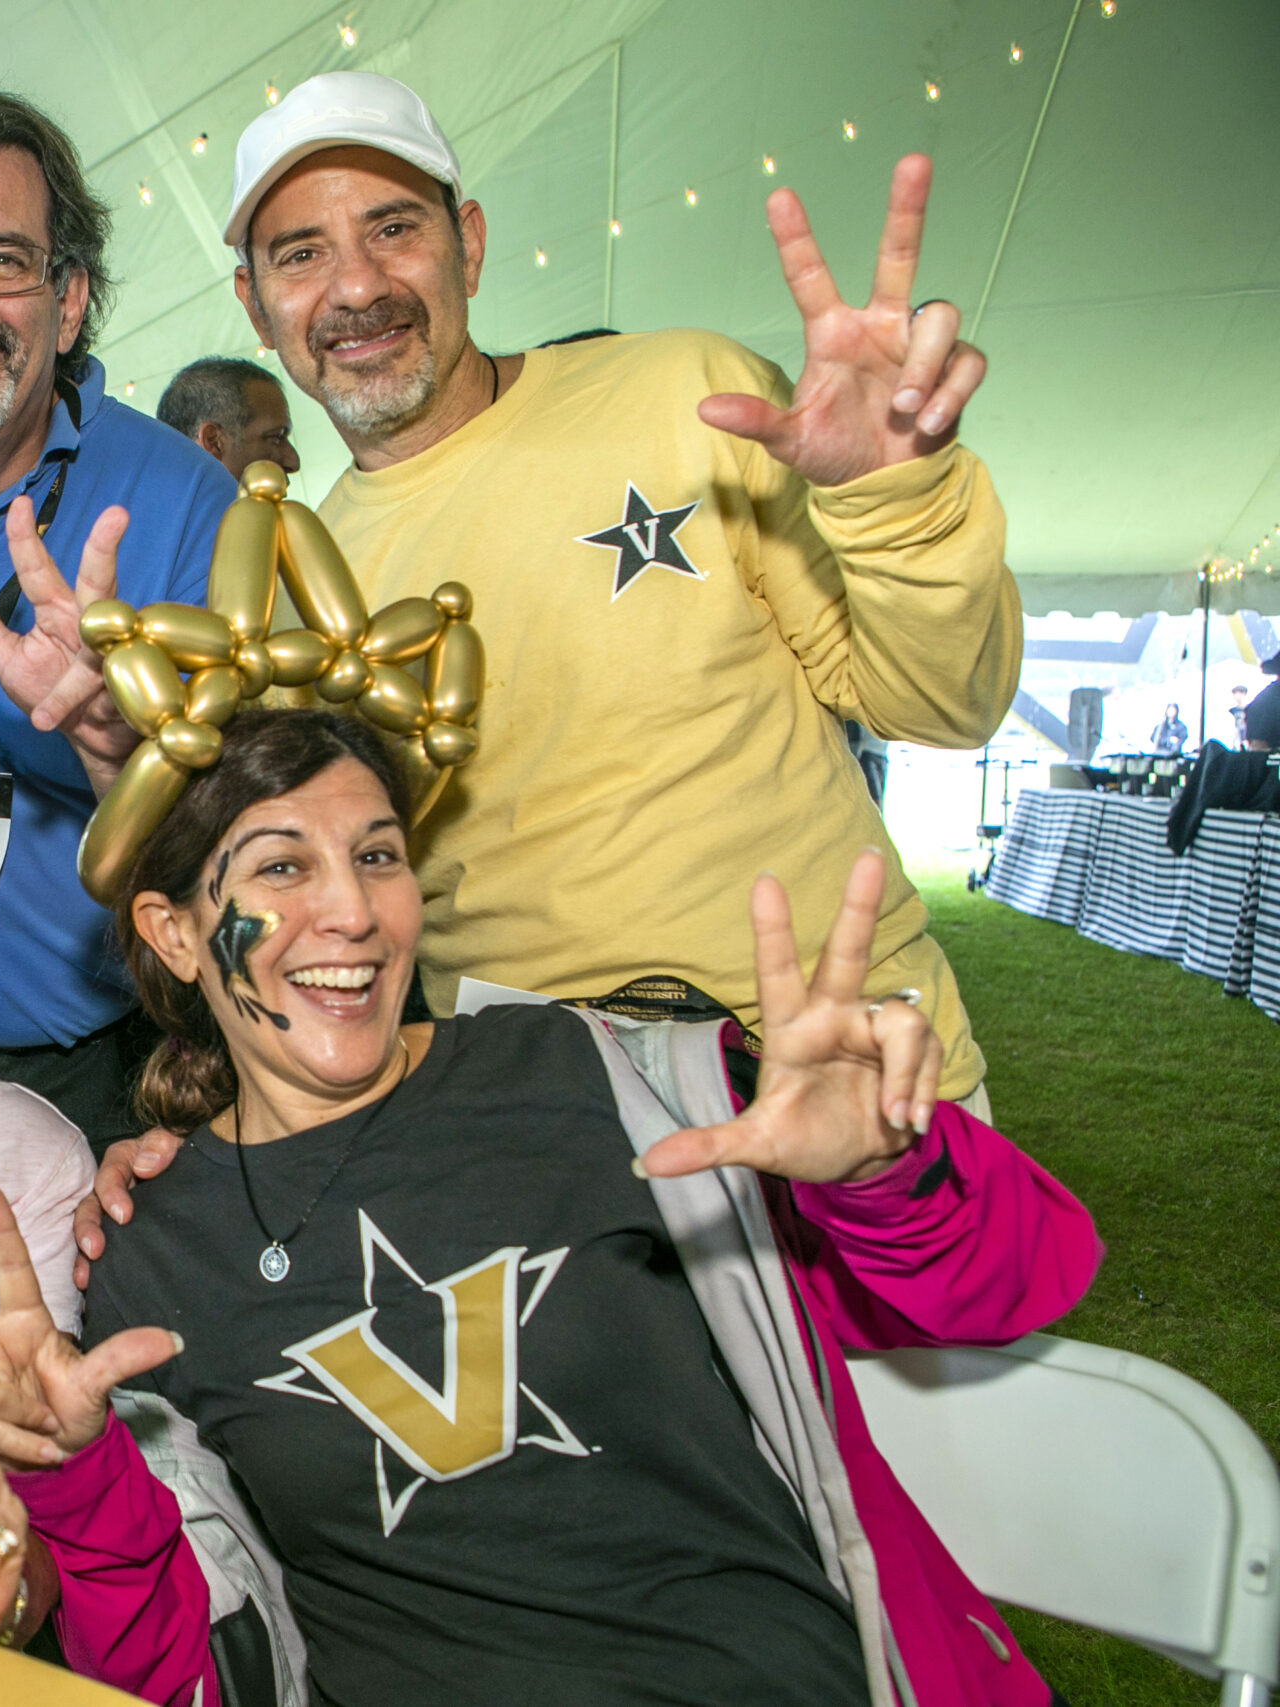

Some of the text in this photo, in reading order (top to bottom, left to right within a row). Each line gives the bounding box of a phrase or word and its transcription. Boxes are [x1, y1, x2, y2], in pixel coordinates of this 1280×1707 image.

[622, 517, 660, 560] V
[625, 989, 687, 1000] UNIVERSITY
[281, 1246, 528, 1482] V
